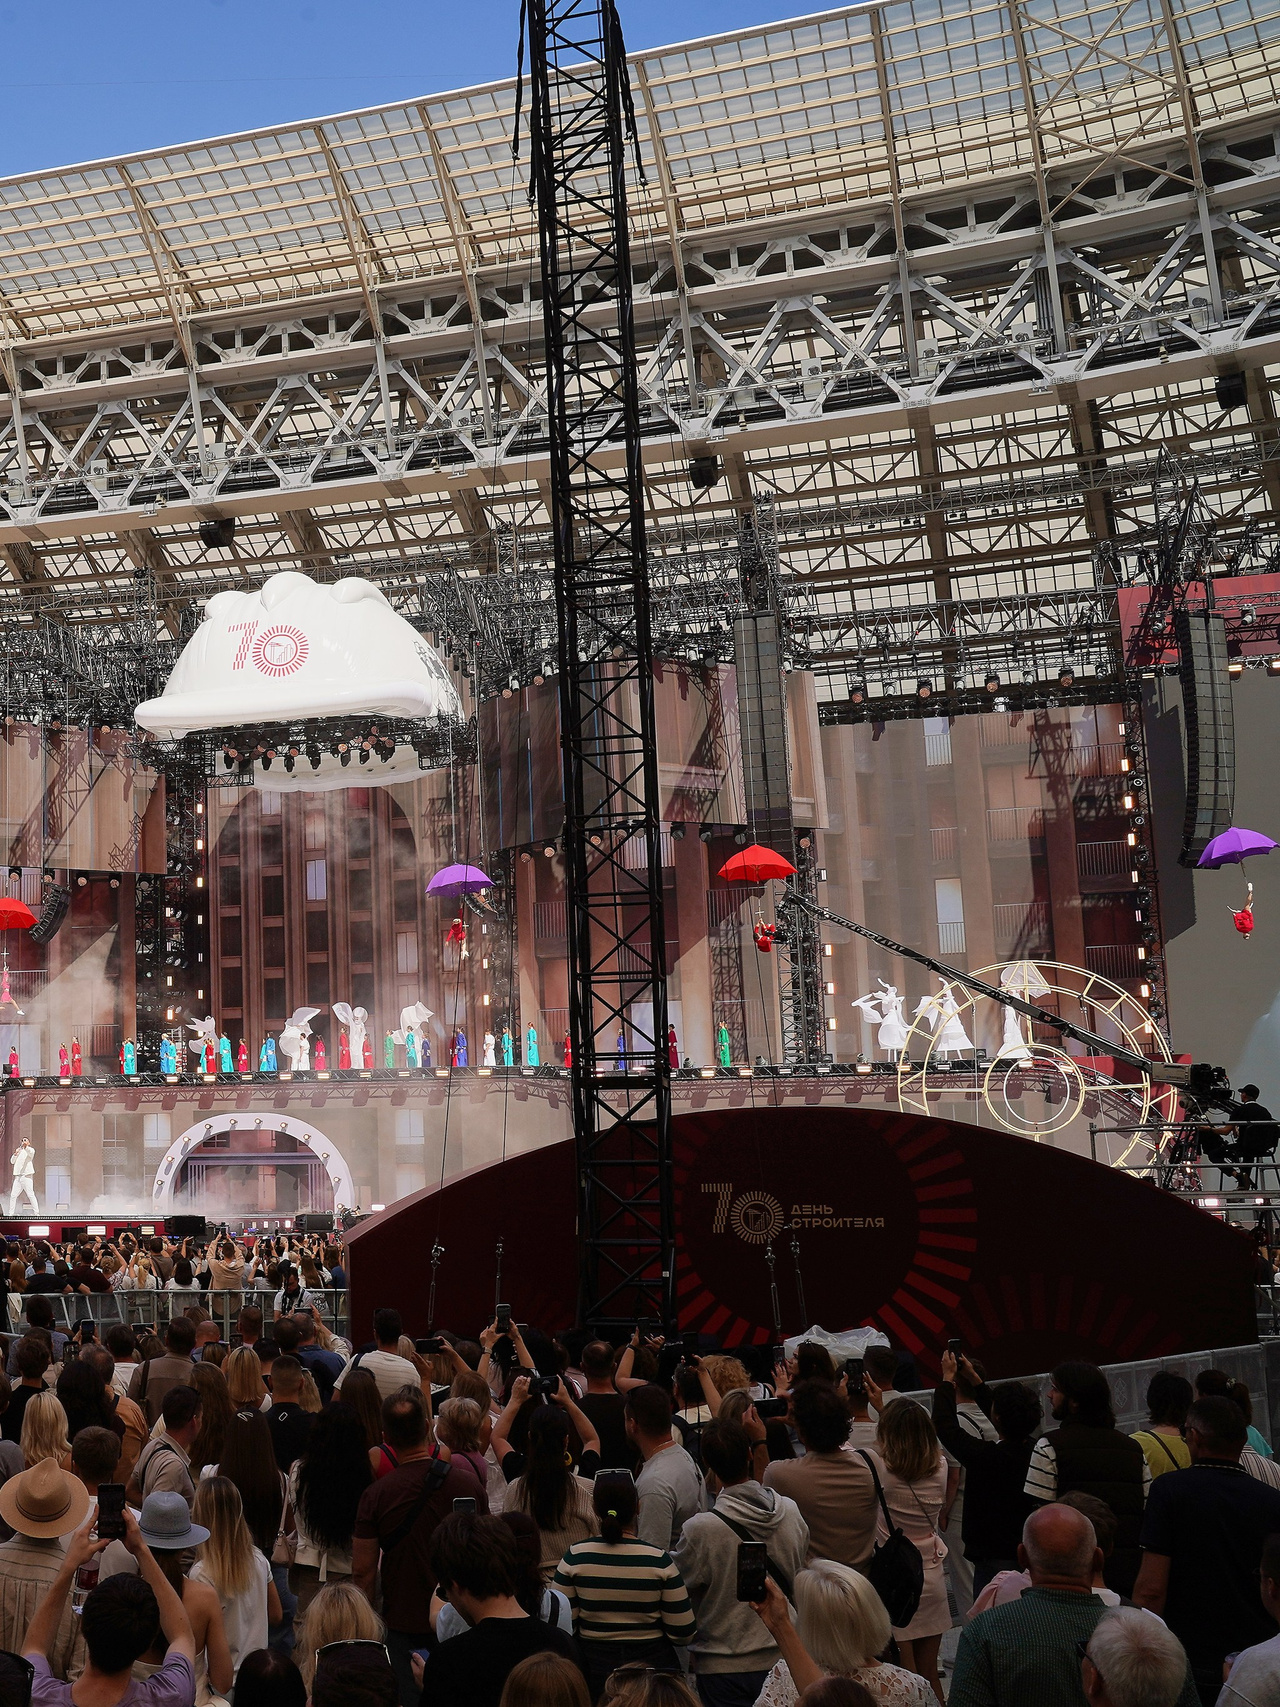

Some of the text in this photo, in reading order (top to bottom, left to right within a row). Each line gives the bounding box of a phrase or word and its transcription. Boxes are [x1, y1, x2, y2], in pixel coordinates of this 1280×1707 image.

[227, 619, 310, 678] 70
[700, 1183, 785, 1245] 70
[790, 1204, 833, 1215] ДЕНЬ
[791, 1217, 885, 1228] СТРОИТЕЛЯ
